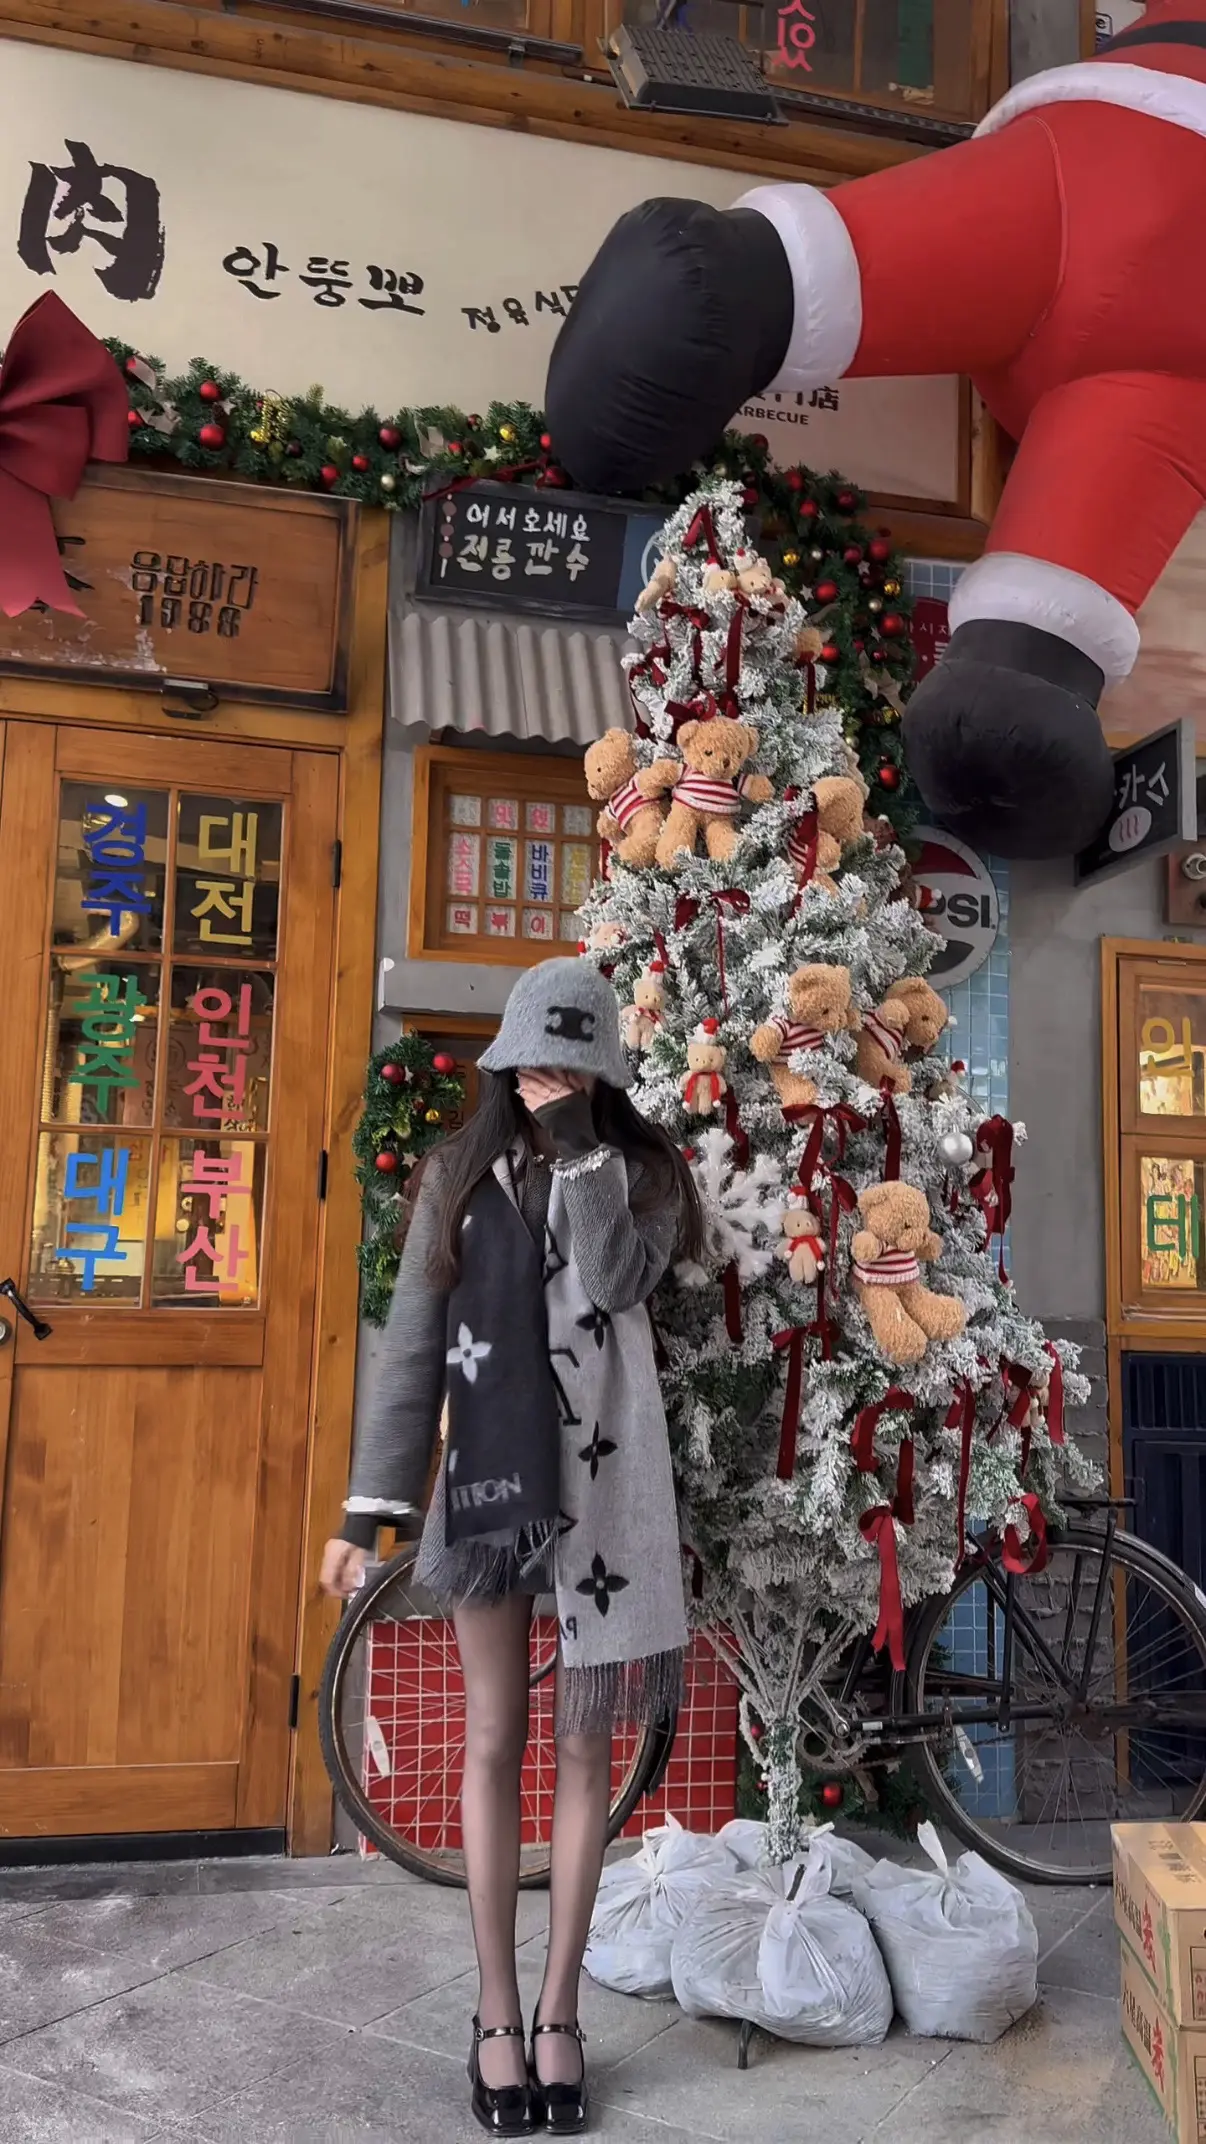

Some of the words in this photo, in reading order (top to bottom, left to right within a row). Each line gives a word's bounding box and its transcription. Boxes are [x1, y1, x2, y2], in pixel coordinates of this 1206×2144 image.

[17, 138, 166, 303] 肉
[130, 550, 259, 610] 응답하라
[465, 502, 591, 542] 어서오세요
[139, 594, 241, 638] 1988
[80, 803, 151, 937] 경주
[190, 812, 258, 945] 대전
[69, 973, 148, 1116] 광주
[183, 983, 252, 1120] 인천
[55, 1148, 130, 1292] 대구
[176, 1150, 252, 1292] 부산
